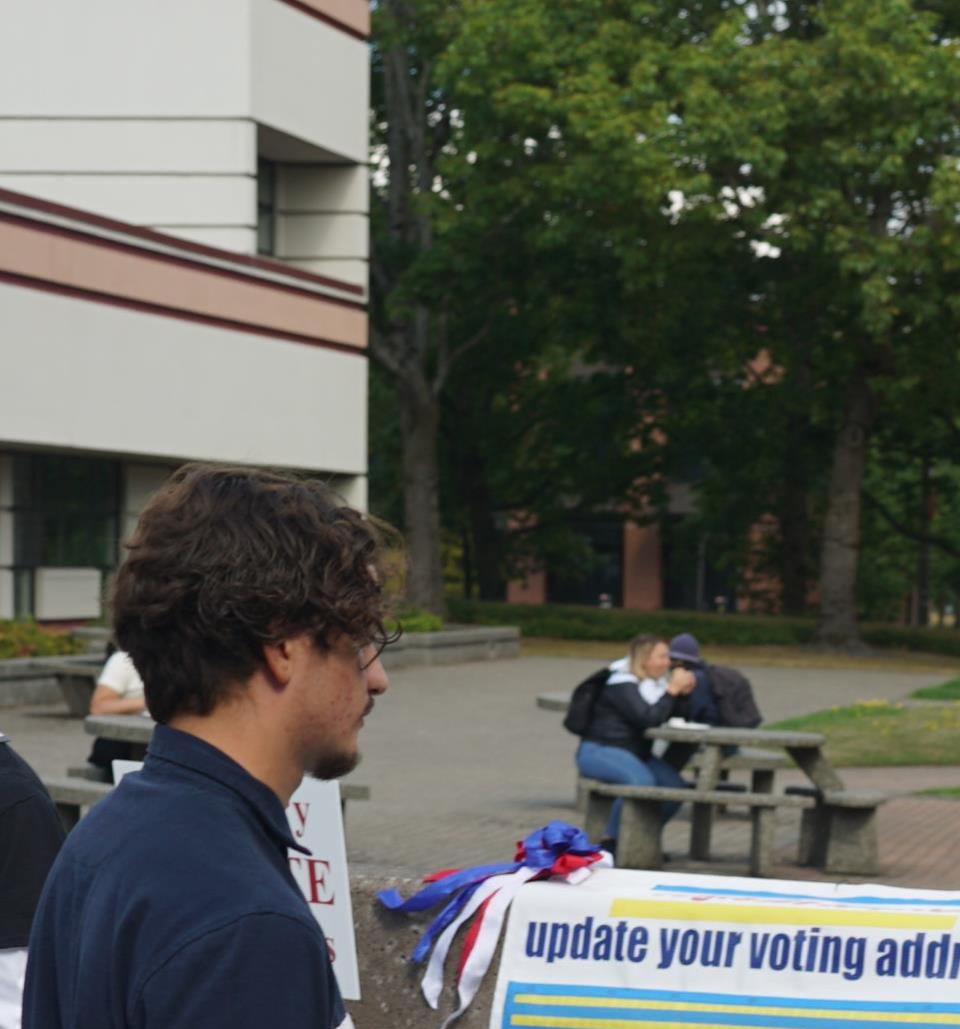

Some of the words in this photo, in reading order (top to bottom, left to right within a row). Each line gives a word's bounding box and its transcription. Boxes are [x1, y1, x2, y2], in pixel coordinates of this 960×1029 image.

[525, 917, 649, 965] update
[657, 930, 743, 971] your
[748, 926, 866, 981] voting
